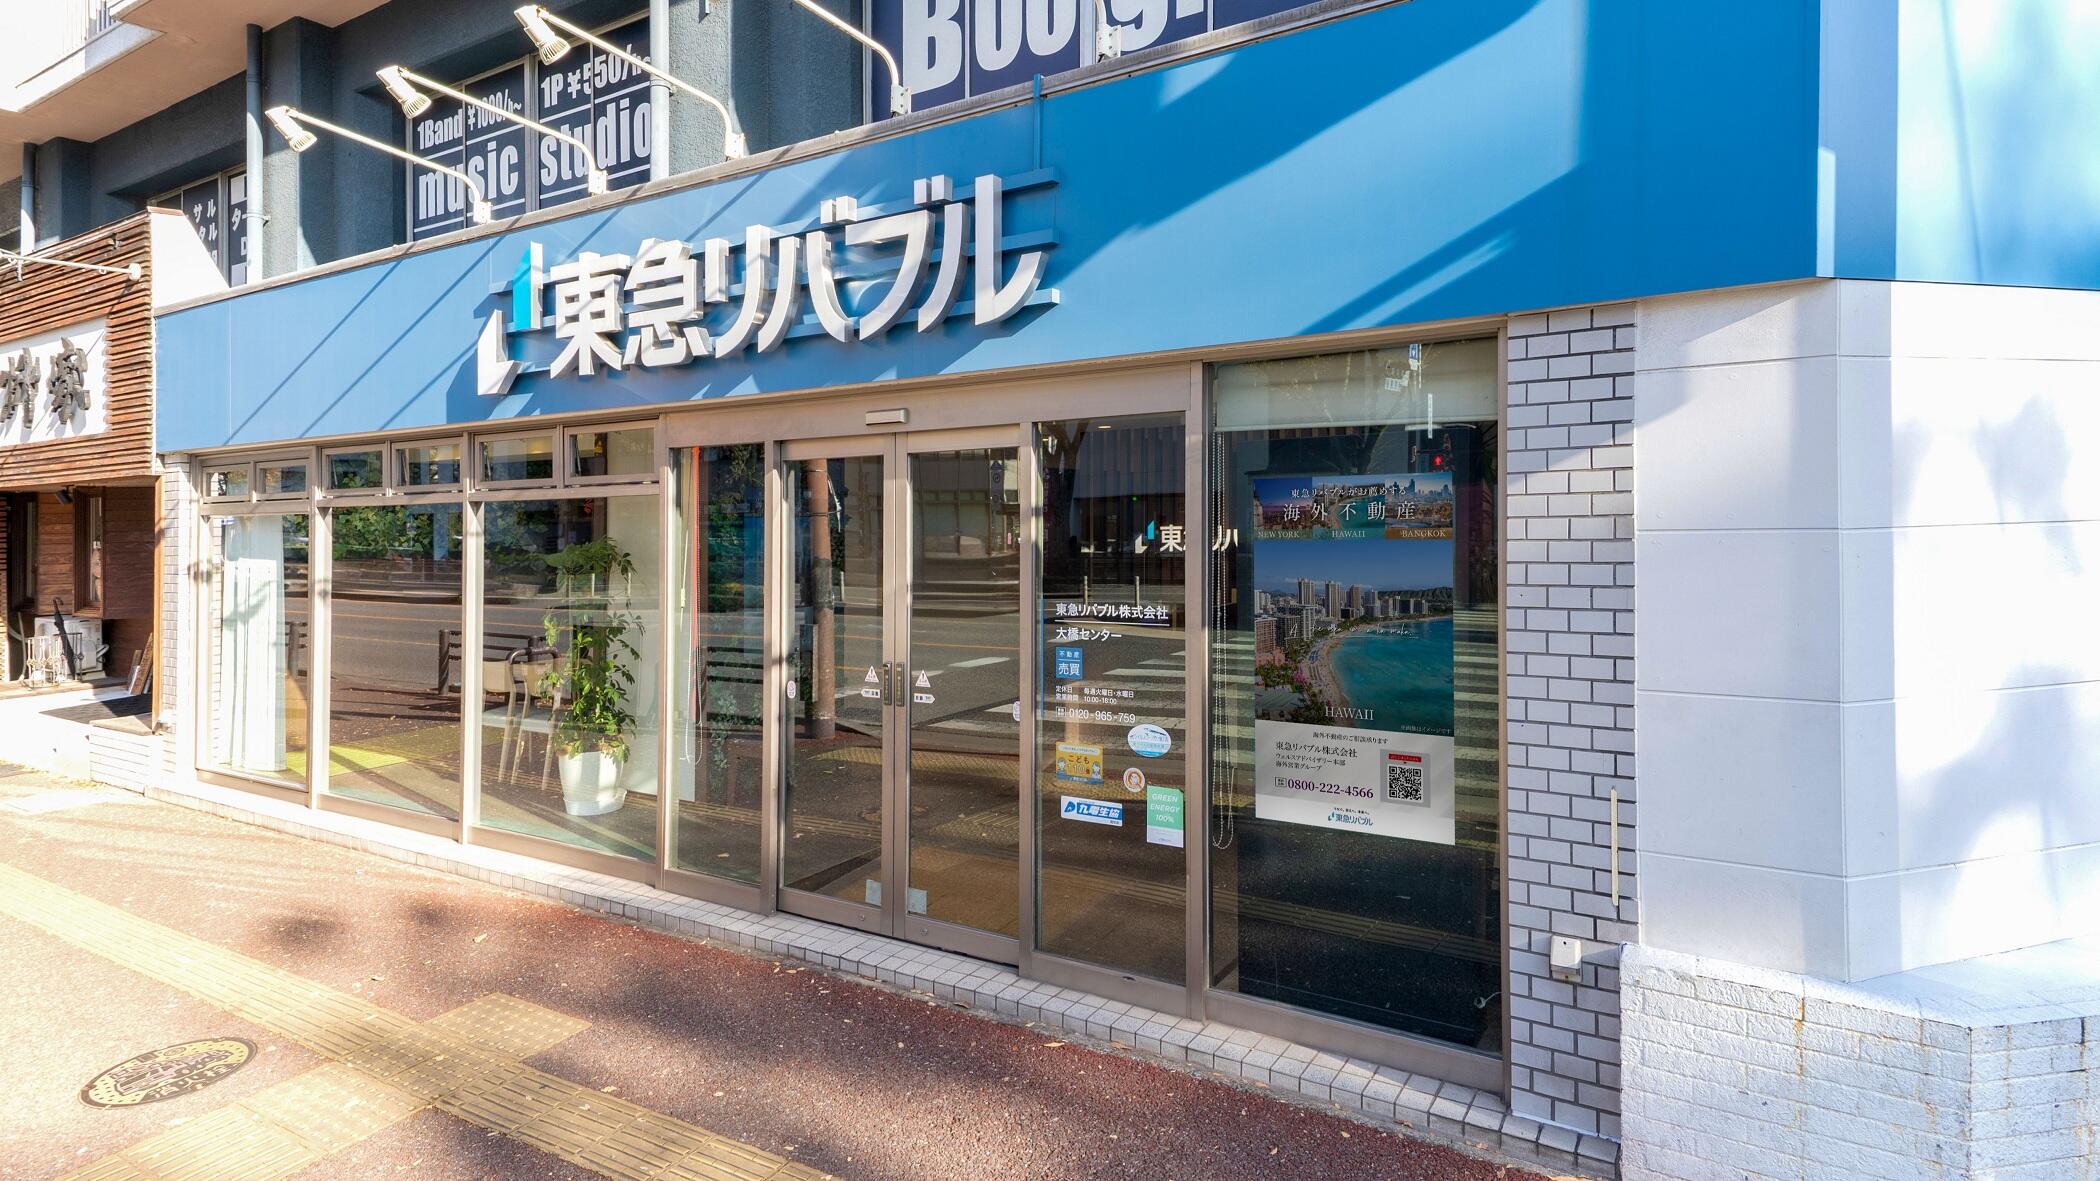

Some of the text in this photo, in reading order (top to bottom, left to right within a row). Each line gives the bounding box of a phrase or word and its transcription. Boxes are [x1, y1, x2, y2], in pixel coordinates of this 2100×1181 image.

[541, 72, 564, 109] 1P
[417, 108, 463, 150] 1Band
[418, 96, 651, 221] music studio
[549, 174, 1049, 380] 東急リバブル
[1284, 500, 1417, 522] 海外不動産
[1278, 530, 1299, 538] YORK
[1332, 530, 1366, 538] HAWAII
[1402, 529, 1446, 538] BANGKOK
[1056, 603, 1169, 620] 東急リバブル株式会社
[1056, 627, 1122, 642] 大橋センター
[1058, 662, 1080, 676] 売買
[1325, 706, 1375, 721] HAWAII
[1275, 740, 1358, 758] 東急リバブル株式会社
[1287, 778, 1374, 799] 0800-222-4566
[1151, 793, 1178, 803] GREEN
[1150, 803, 1180, 813] ENERGY
[1156, 814, 1175, 823] 100%
[1335, 813, 1374, 826] 東急リバブル
